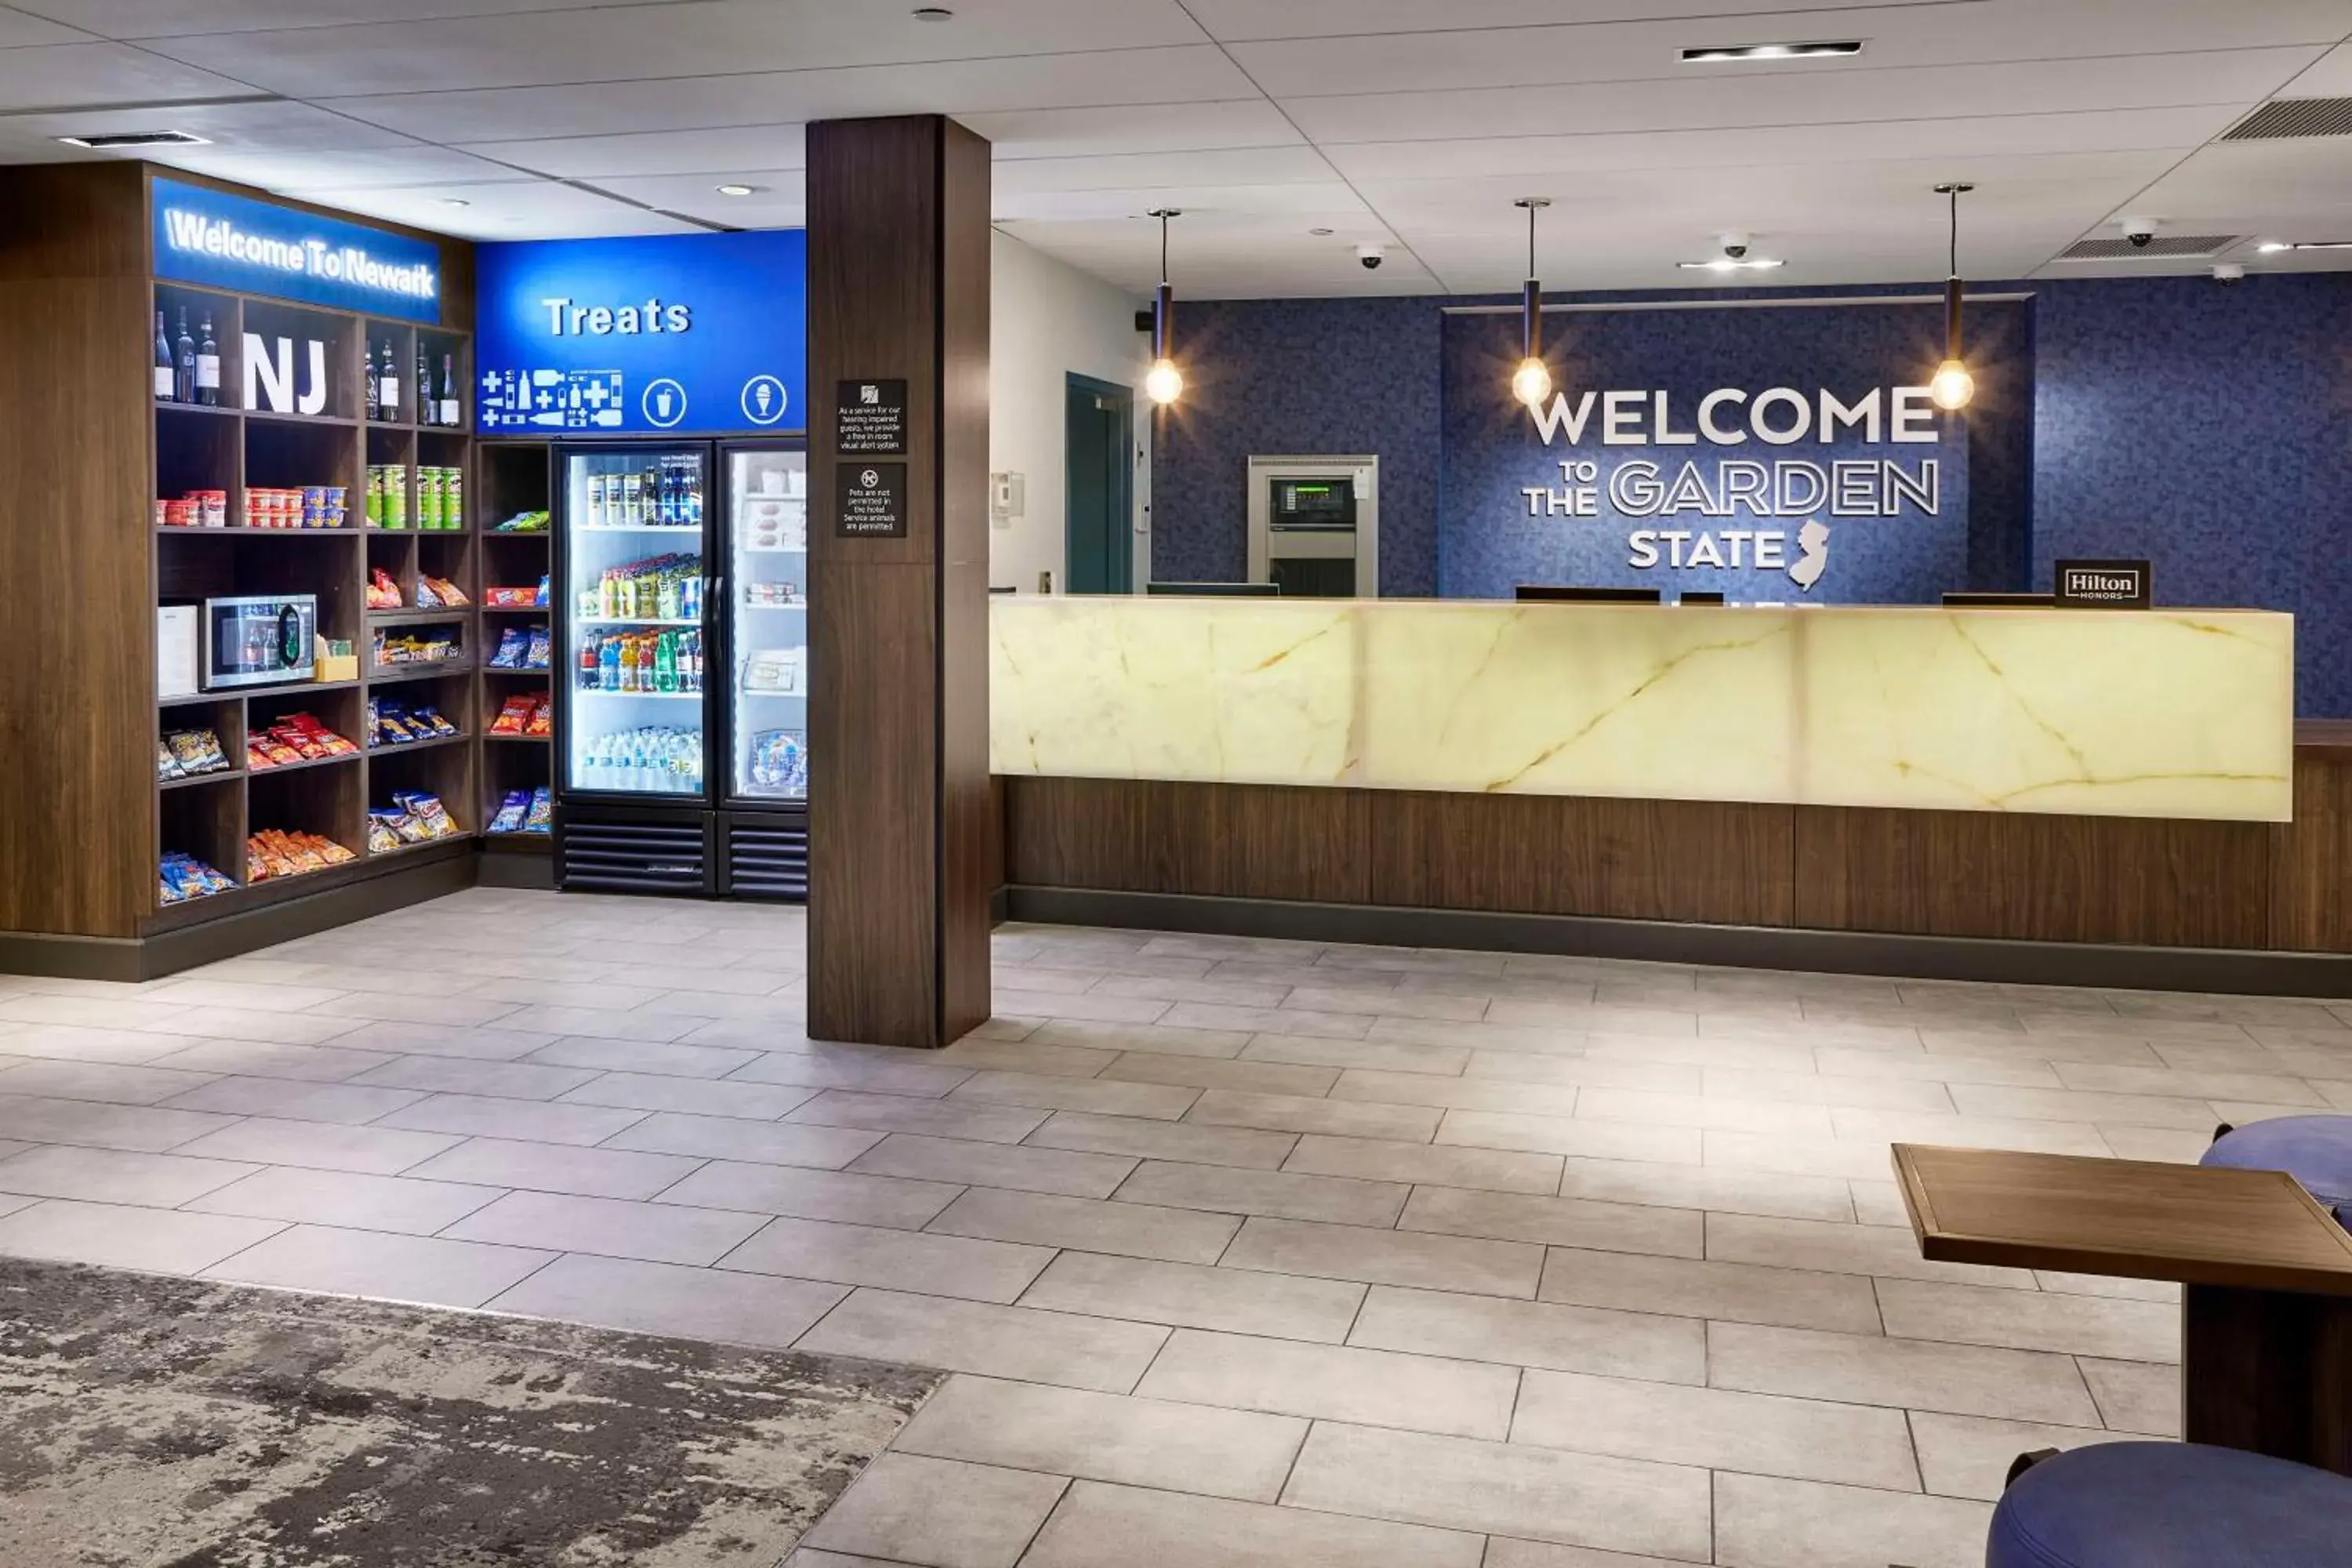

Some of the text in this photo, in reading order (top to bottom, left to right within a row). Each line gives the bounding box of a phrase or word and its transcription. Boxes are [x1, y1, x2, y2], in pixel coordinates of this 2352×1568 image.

[165, 209, 434, 298] Welcome To Newark
[543, 298, 692, 335] Treats
[243, 332, 328, 415] NJ
[1529, 387, 1940, 446] WELCOME
[877, 441, 898, 450] system
[1522, 459, 1940, 517] THE GARDEN
[1559, 461, 1597, 483] TO
[1628, 531, 1786, 568] STATE
[2071, 575, 2132, 590] Hilton
